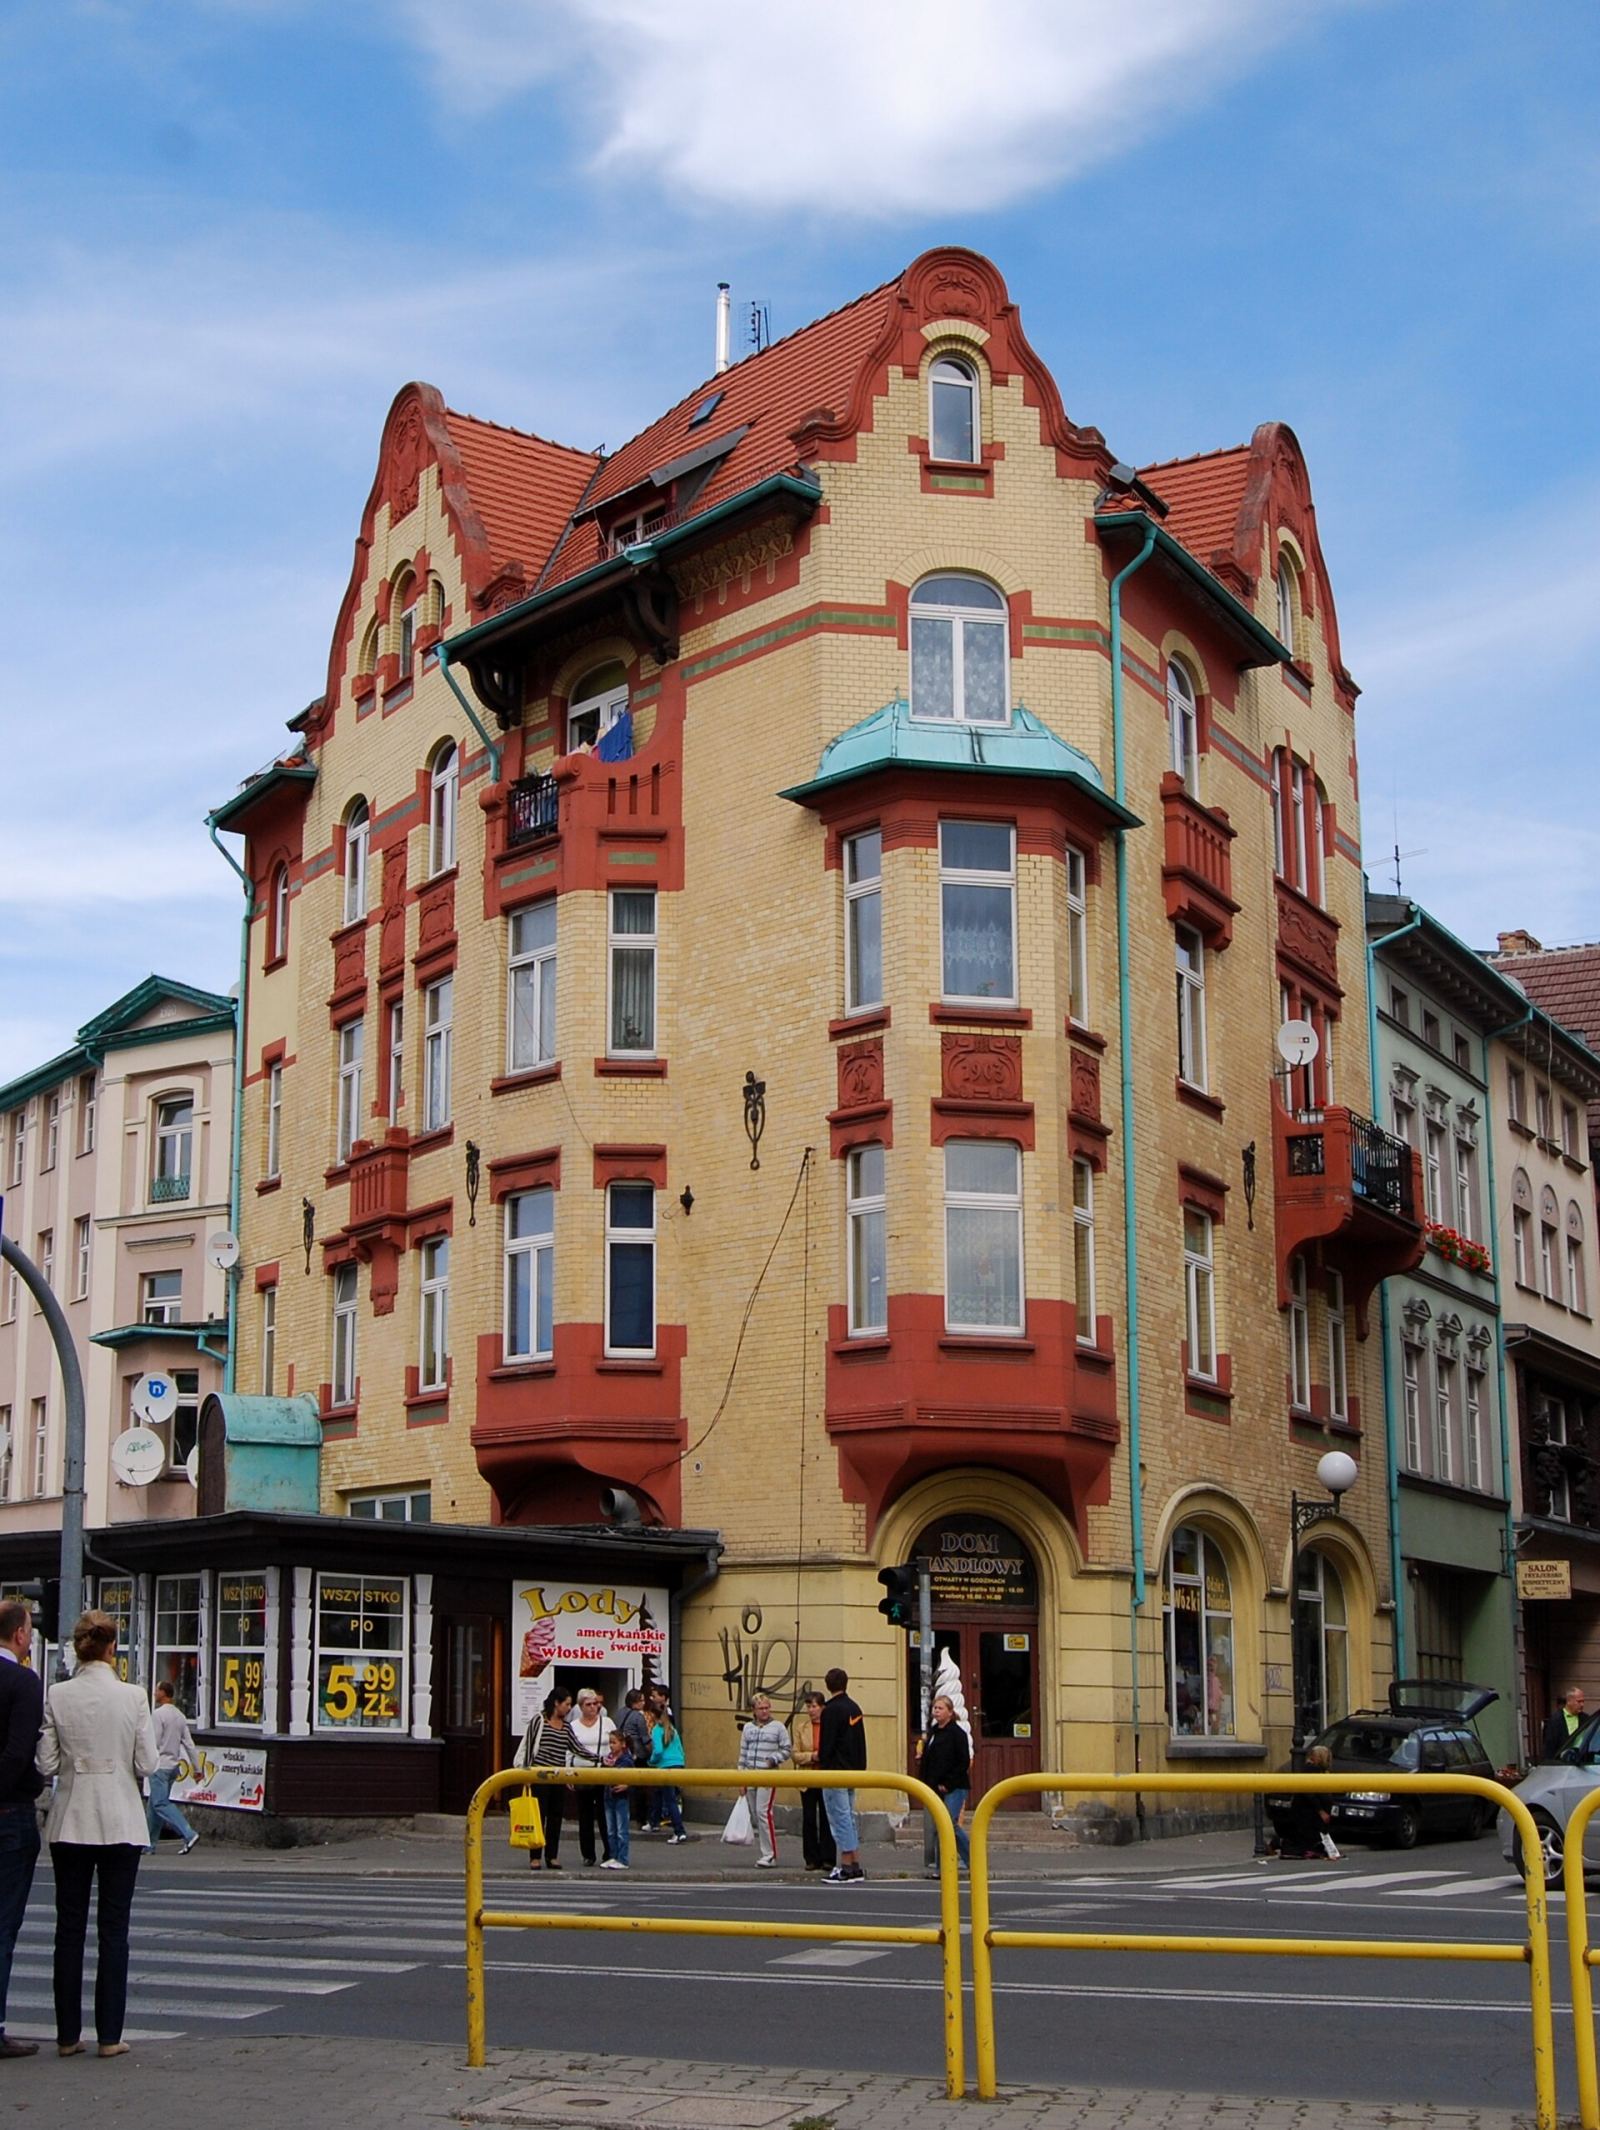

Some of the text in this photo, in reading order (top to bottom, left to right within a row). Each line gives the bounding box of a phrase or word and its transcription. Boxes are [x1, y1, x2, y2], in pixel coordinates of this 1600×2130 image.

[941, 1532, 999, 1554] DOM
[1528, 1564, 1558, 1573] SALON
[223, 1585, 265, 1601] WSZYSTKO
[322, 1588, 400, 1604] WSZYSTKO
[1174, 1587, 1201, 1612] Wózki
[519, 1587, 641, 1625] Lody
[238, 1618, 250, 1632] PO
[350, 1619, 374, 1633] PO
[576, 1628, 666, 1641] amerykańskie
[541, 1645, 605, 1660] włoskie
[610, 1642, 662, 1654] świderki
[223, 1658, 260, 1718] 5 99
[325, 1663, 396, 1720] 5 99
[243, 1692, 260, 1718] ZŁ
[362, 1692, 395, 1717] ZŁ
[240, 1781, 246, 1796] 5
